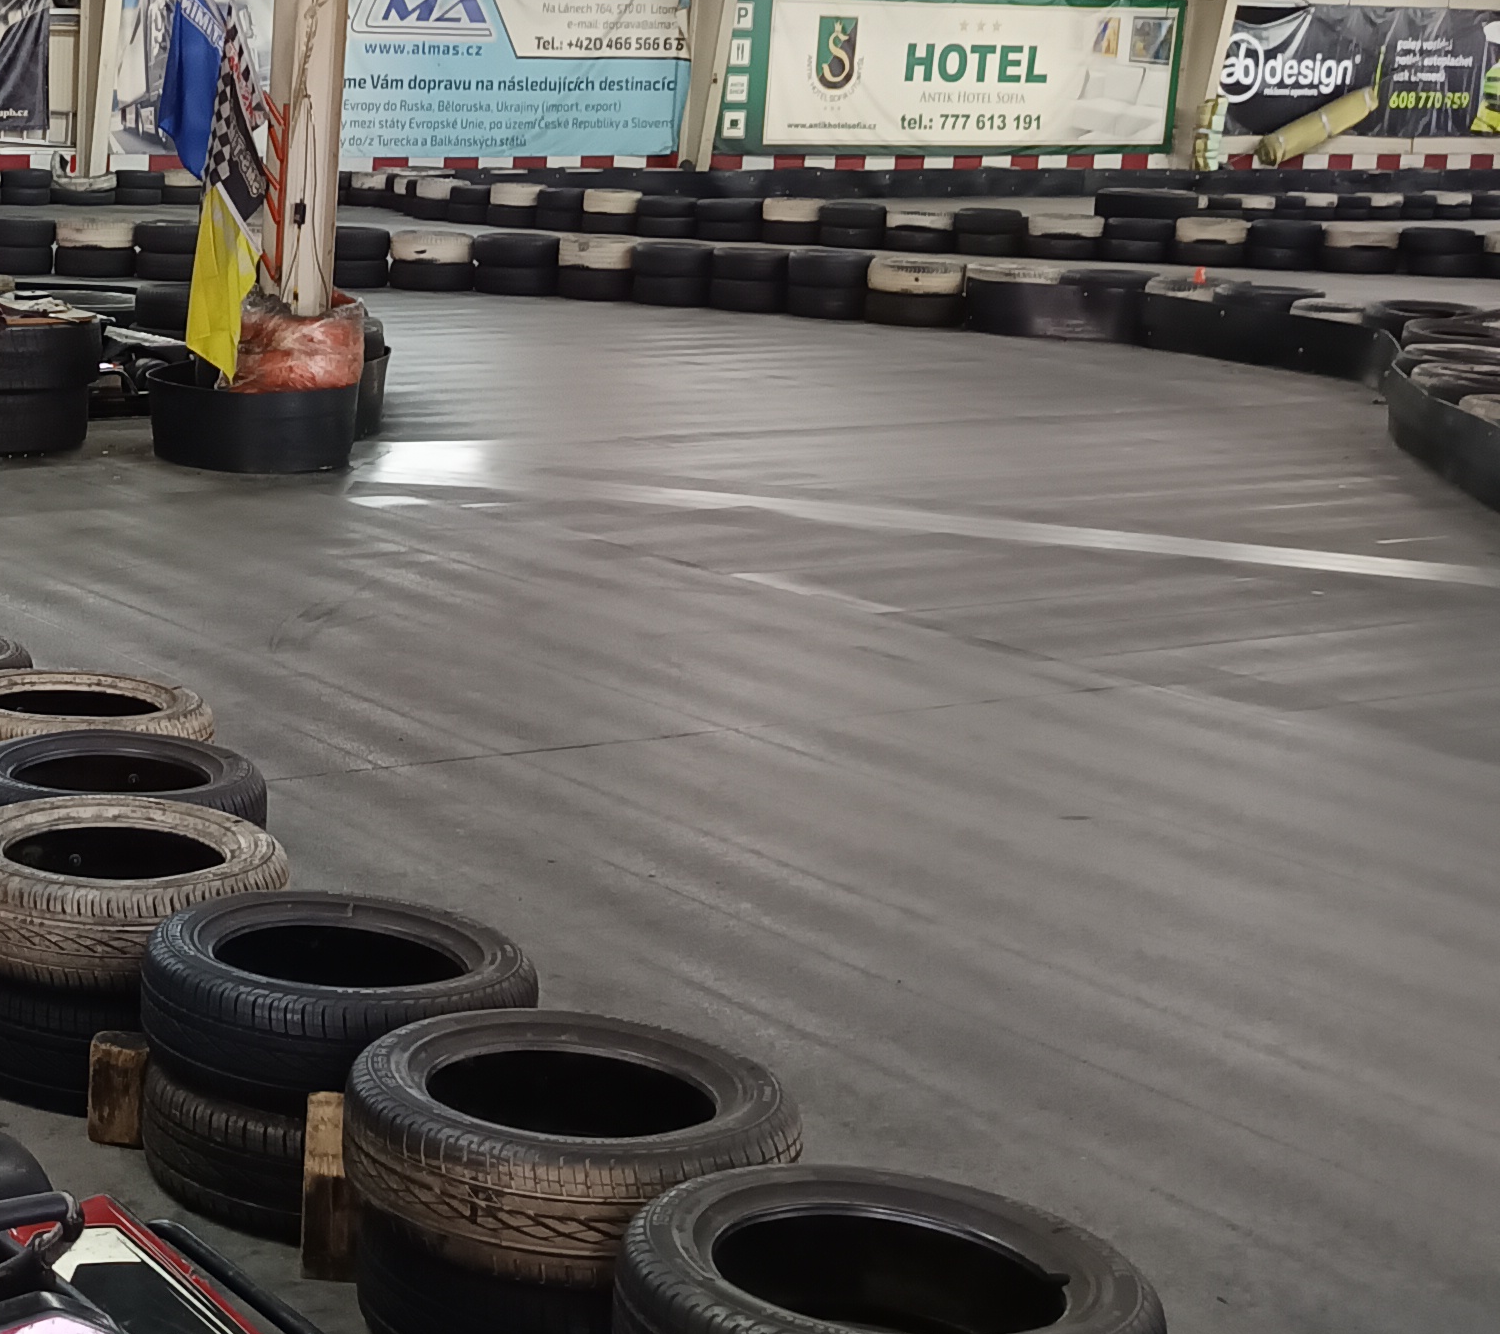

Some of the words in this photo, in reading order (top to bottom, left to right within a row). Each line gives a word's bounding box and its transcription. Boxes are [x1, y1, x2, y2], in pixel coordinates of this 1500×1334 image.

[558, 2, 593, 14] Lánech
[737, 6, 749, 25] P
[364, 40, 483, 56] www.almas.cz
[535, 36, 563, 51] Tel.:
[567, 36, 603, 51] +420
[606, 37, 632, 51] 466
[635, 37, 660, 51] 566
[904, 43, 1047, 83] HOTEL
[1264, 53, 1353, 95] design
[370, 74, 404, 90] Vám
[408, 75, 471, 94] dopravu
[476, 79, 494, 91] na
[498, 75, 595, 95] následujících
[343, 99, 381, 114] Evropy
[384, 100, 397, 112] do
[399, 99, 435, 114] Ruska,
[438, 99, 494, 114] Běloruska,
[496, 101, 539, 115] Ukrajiny
[584, 101, 622, 115] export)
[1389, 90, 1416, 109] 608
[1418, 91, 1443, 109] 770
[349, 118, 375, 129] mezi
[378, 118, 407, 132] státy
[409, 117, 458, 132] Evropské
[461, 118, 487, 131] Unie,
[489, 120, 503, 132] po
[571, 117, 620, 131] Republiky
[622, 120, 629, 128] a
[900, 113, 933, 130] tel.:
[939, 114, 971, 130] 777
[976, 114, 1007, 131] 613
[1013, 114, 1041, 130] 191
[348, 135, 375, 147] do/z
[377, 135, 419, 147] Turecka
[421, 138, 428, 147] a
[430, 135, 497, 149] Balkánských
[499, 134, 527, 147] států
